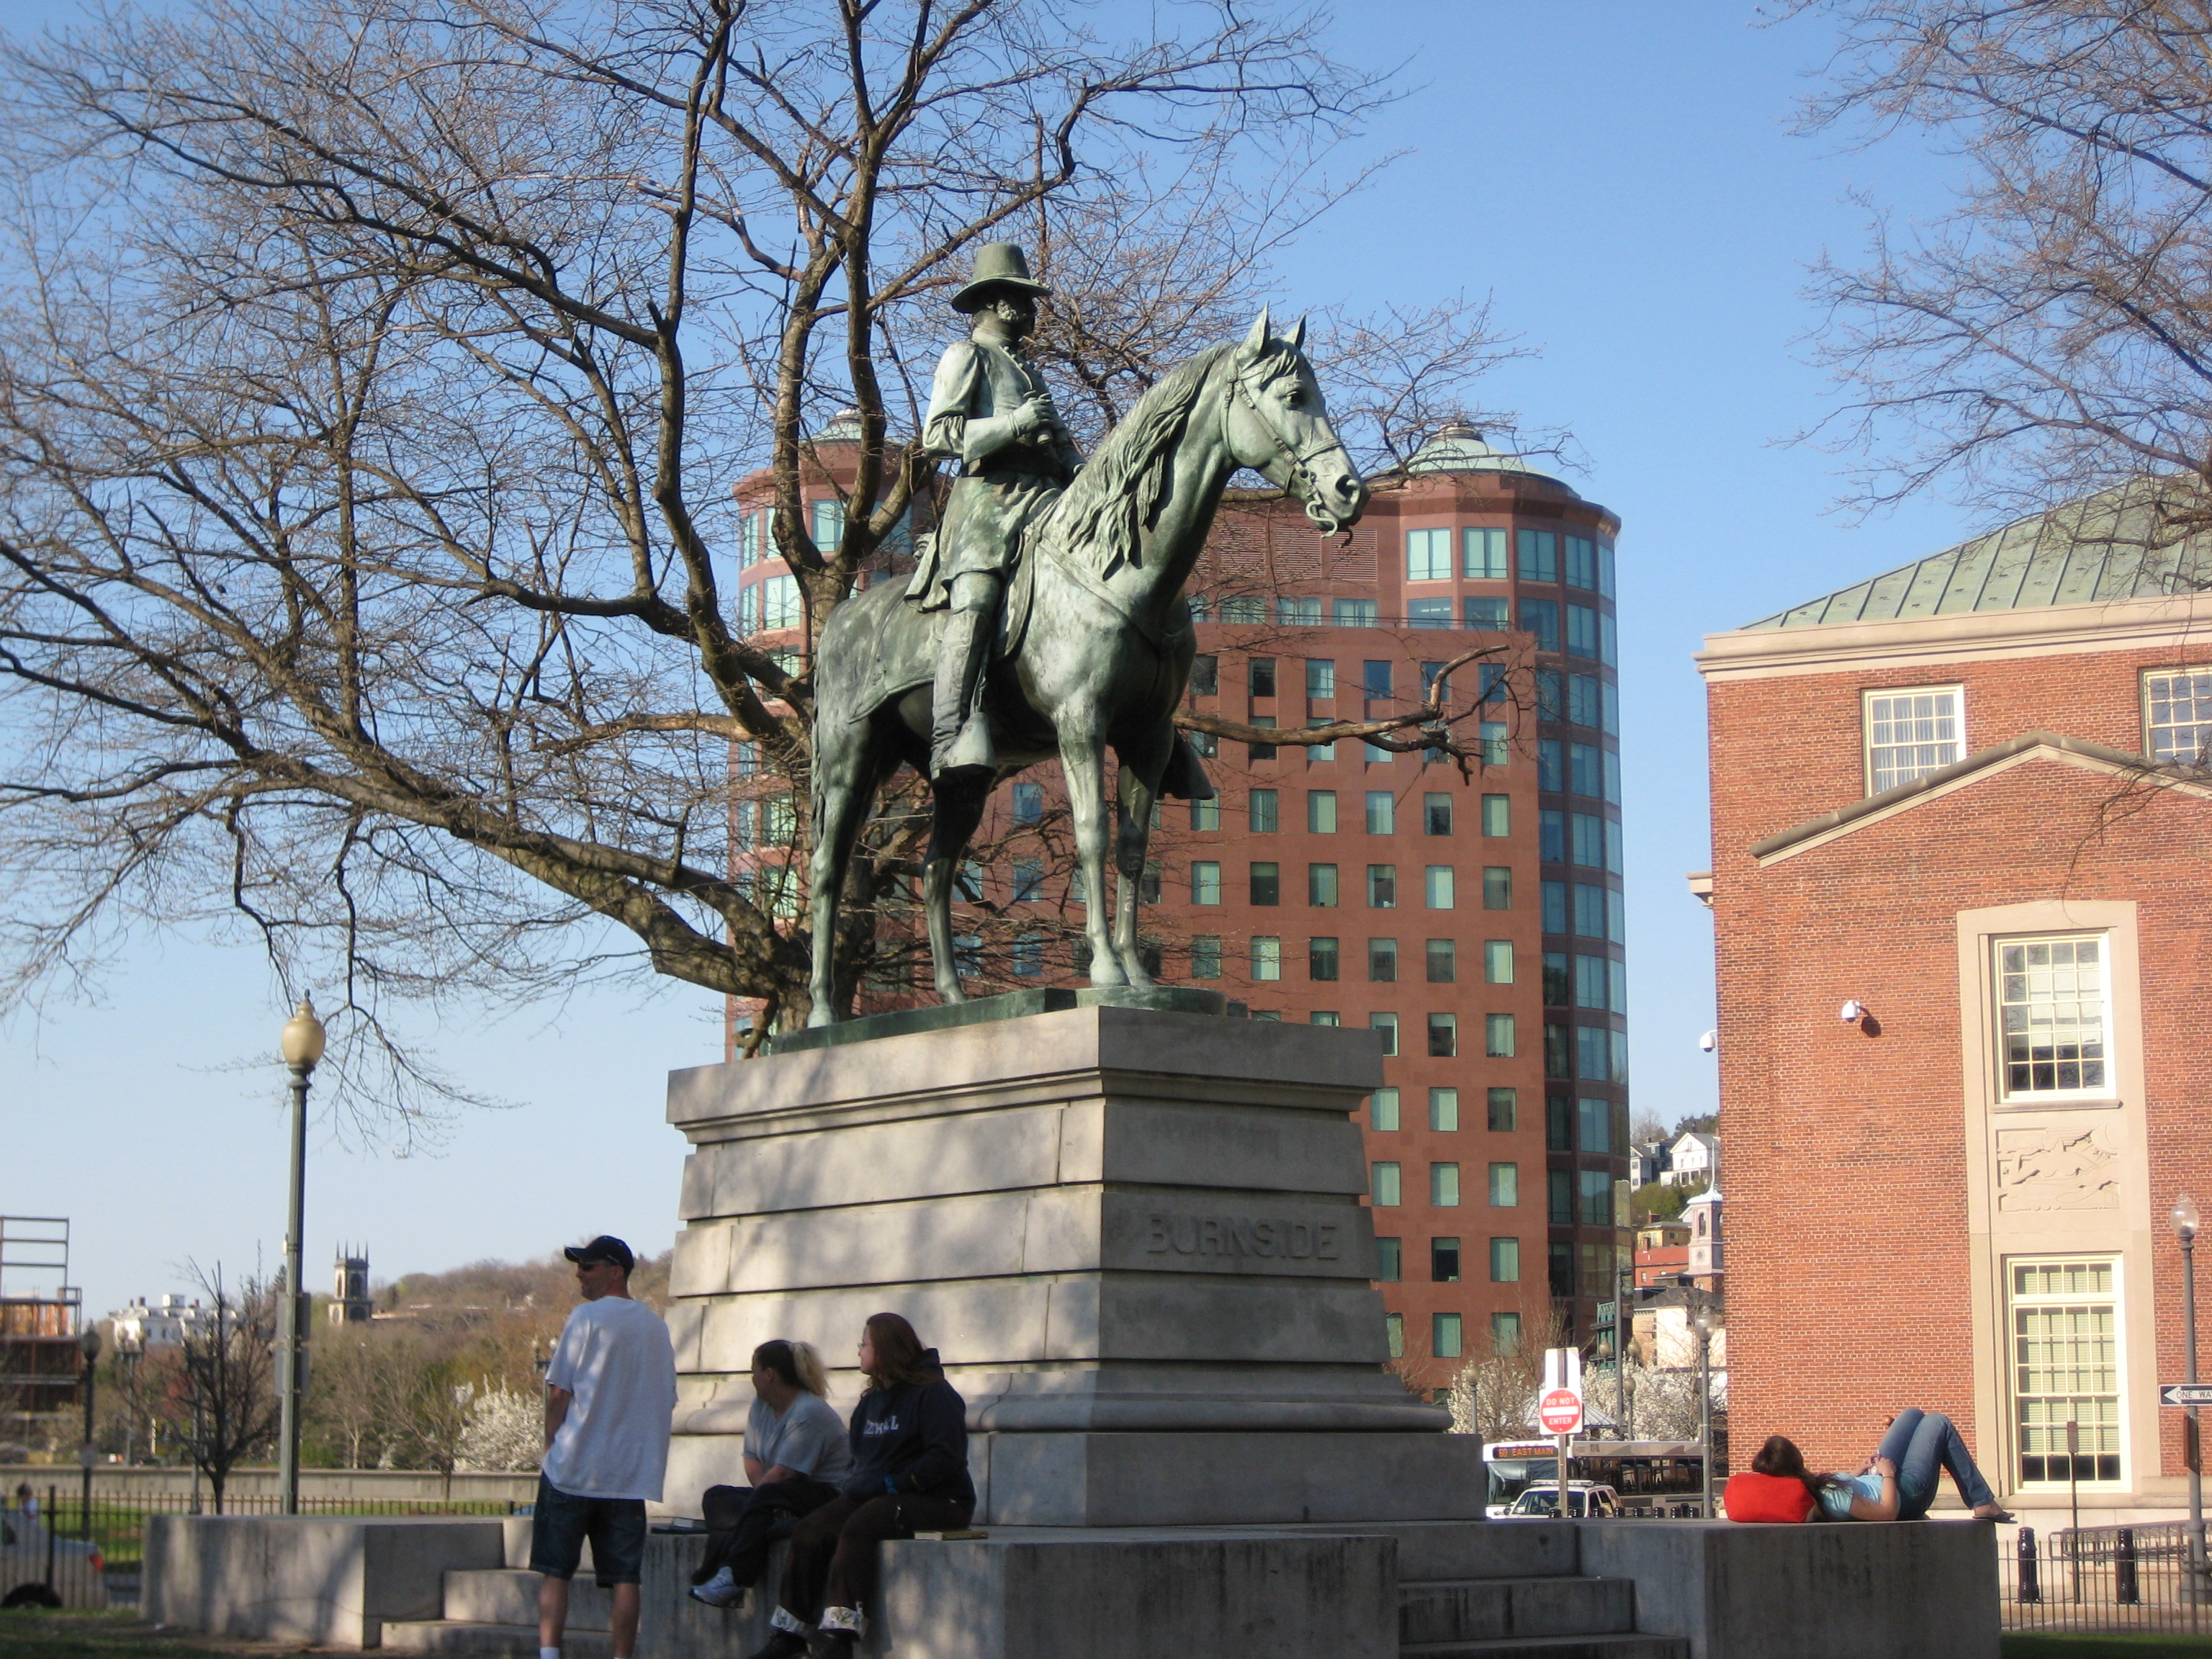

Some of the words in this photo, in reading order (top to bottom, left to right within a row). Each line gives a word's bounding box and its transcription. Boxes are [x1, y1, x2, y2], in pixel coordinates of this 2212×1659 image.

[1147, 1213, 1339, 1260] BURNSIDE
[1549, 1416, 1573, 1425] ENTER
[1512, 1447, 1532, 1456] EAST
